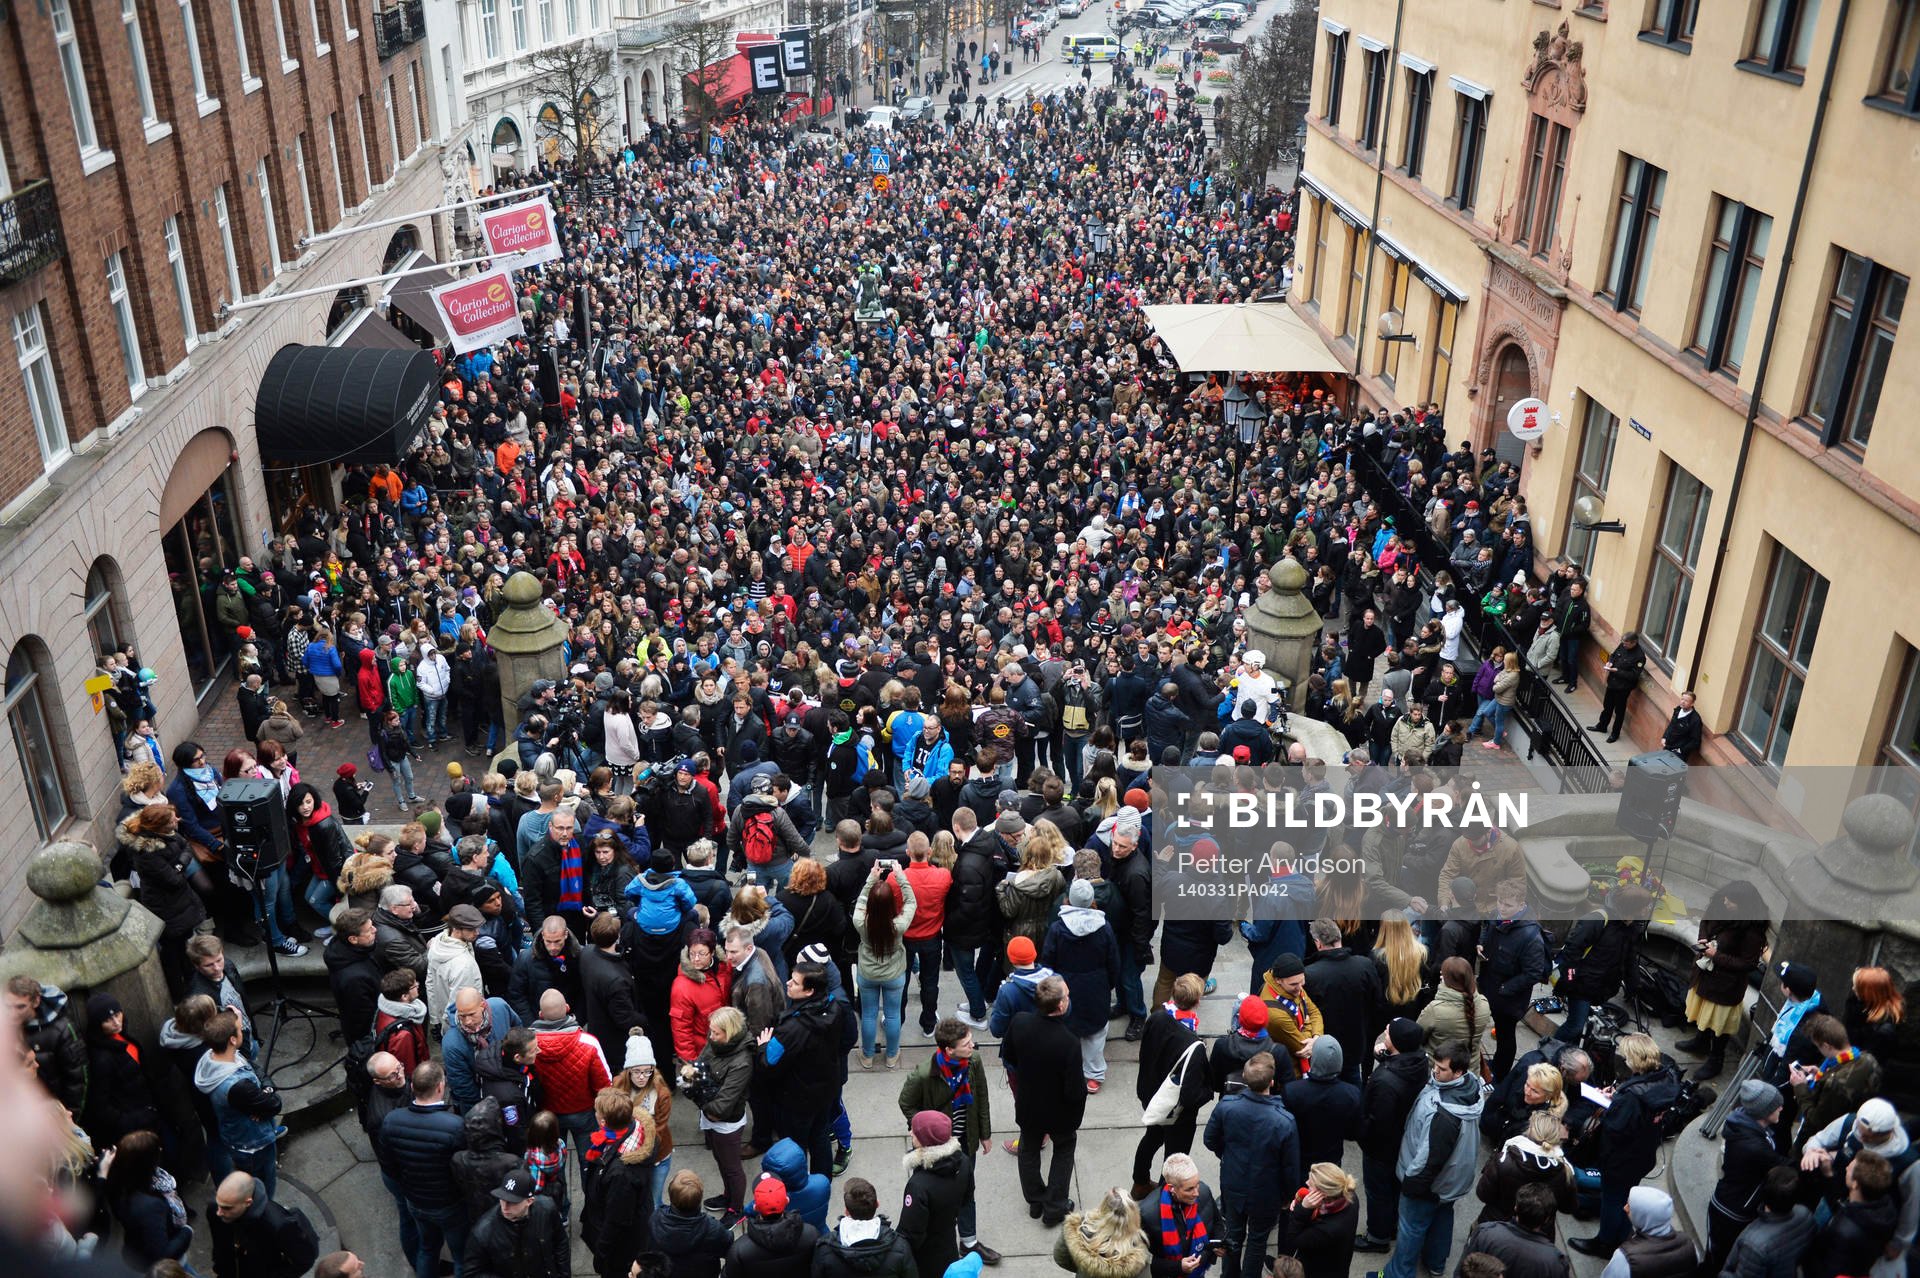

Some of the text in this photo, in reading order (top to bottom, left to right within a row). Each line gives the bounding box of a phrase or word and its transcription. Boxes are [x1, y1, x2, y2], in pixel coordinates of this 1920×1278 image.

[784, 40, 806, 71] E
[754, 56, 779, 89] E
[492, 224, 527, 240] Clarion
[503, 229, 546, 248] Collection
[450, 297, 489, 315] Clarion
[463, 300, 512, 324] Collection
